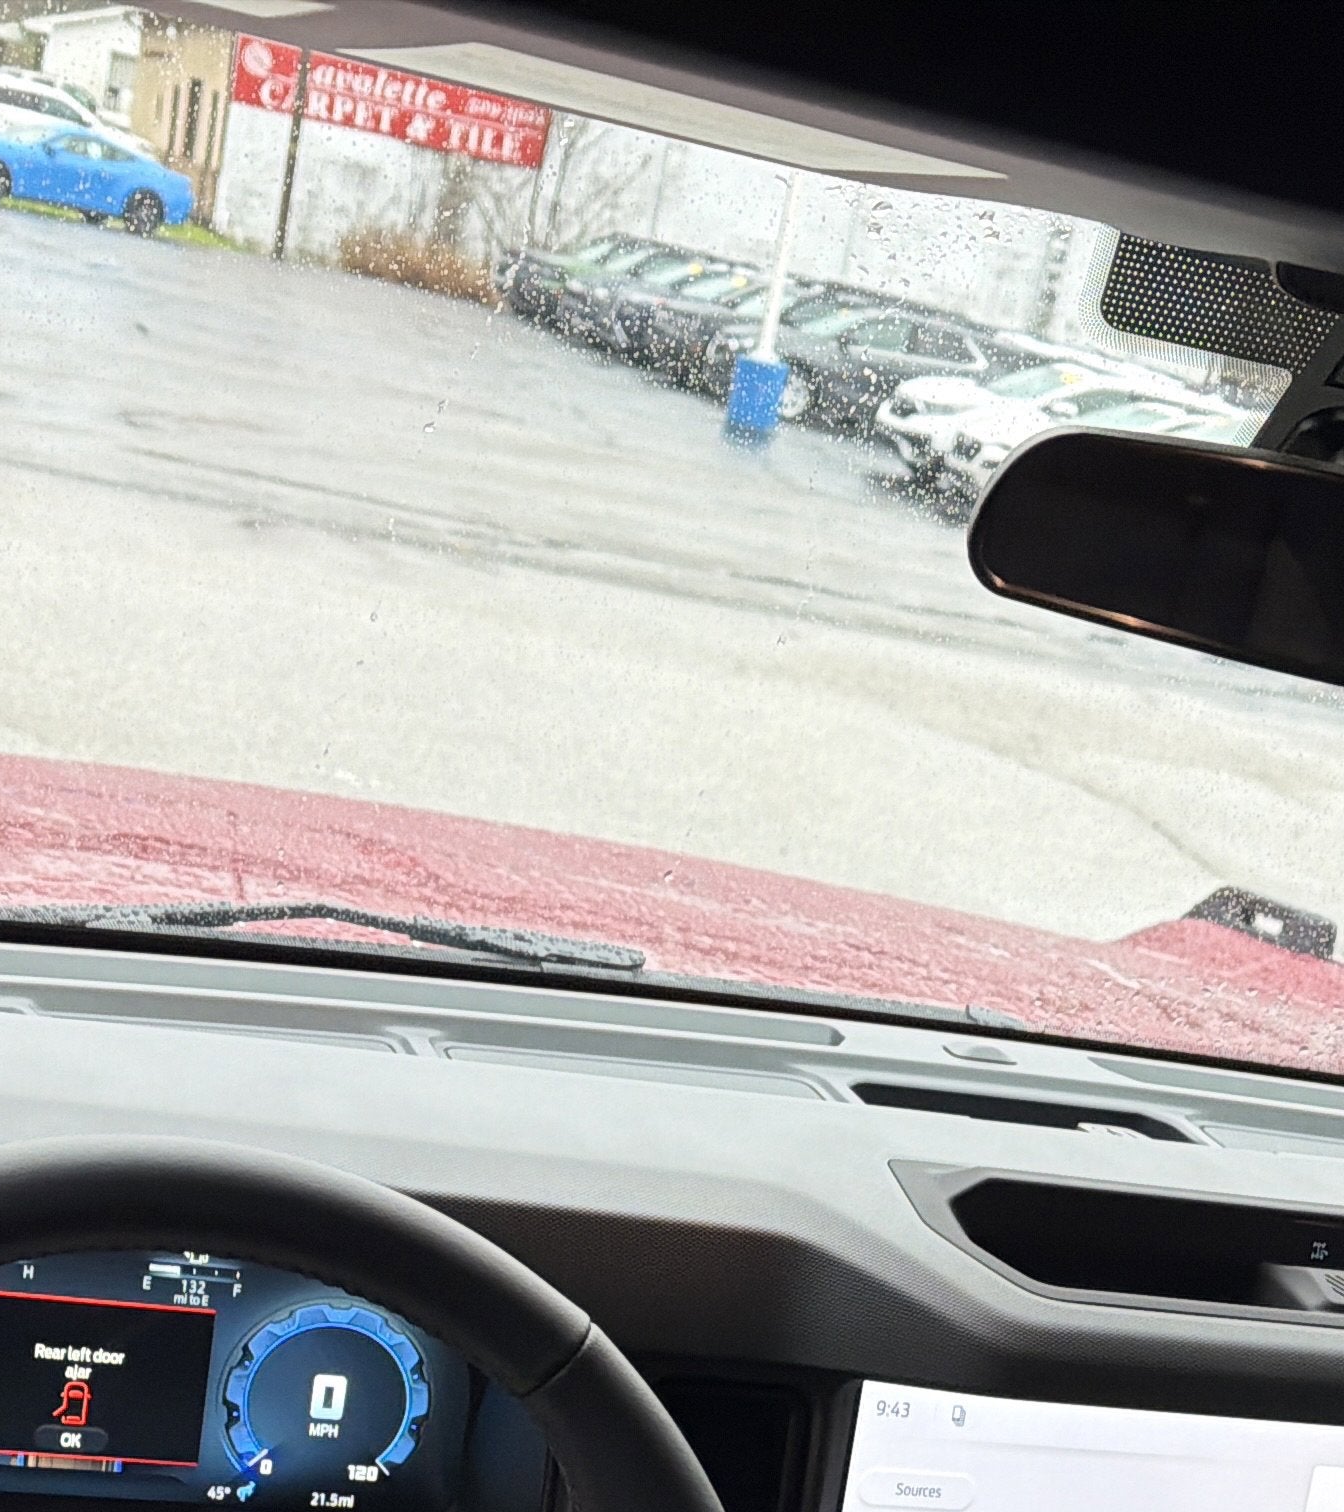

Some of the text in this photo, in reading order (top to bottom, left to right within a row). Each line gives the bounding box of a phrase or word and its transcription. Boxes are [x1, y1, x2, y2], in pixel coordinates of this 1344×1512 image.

[446, 118, 522, 161] TILE
[22, 1265, 34, 1280] H
[142, 1275, 152, 1291] E
[181, 1280, 207, 1295] 132
[232, 1283, 242, 1298] F
[173, 1293, 209, 1307] mi to E
[34, 1343, 125, 1365] Rear left door
[64, 1364, 92, 1381] ajar
[309, 1373, 348, 1421] 0
[876, 1400, 911, 1418] 9:43
[308, 1423, 339, 1438] MPH
[60, 1432, 82, 1448] OK
[259, 1459, 273, 1475] 0
[347, 1464, 379, 1482] 120
[895, 1482, 942, 1498] Sources
